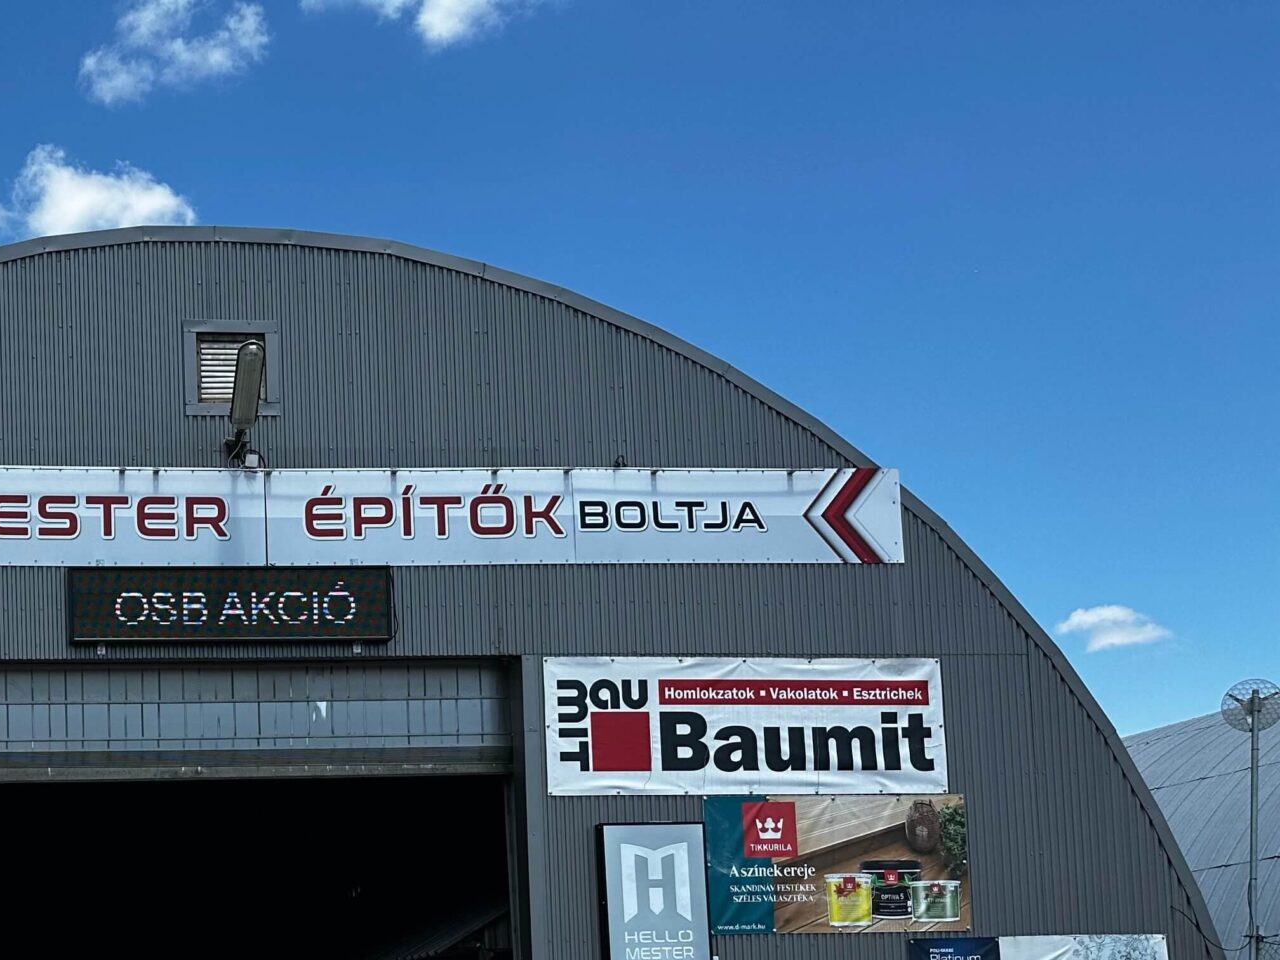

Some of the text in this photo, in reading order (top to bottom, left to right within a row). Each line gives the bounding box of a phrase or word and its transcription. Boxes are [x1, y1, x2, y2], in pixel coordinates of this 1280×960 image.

[304, 484, 566, 537] ÉPÍTŐK
[579, 501, 766, 531] BOLTJA
[115, 581, 356, 625] OSB AKCIÓ
[664, 686, 923, 701] Homlokzatok Vakolatok Esztrichek
[659, 711, 935, 772] Baumit
[750, 843, 793, 851] TIKKURILA
[729, 864, 815, 879] A színek ereje
[729, 883, 817, 893] SKANDINÁV FESTÉKEK
[733, 893, 761, 903] SZÉLES
[624, 930, 694, 944] HELLO
[626, 946, 695, 960] MESTER
